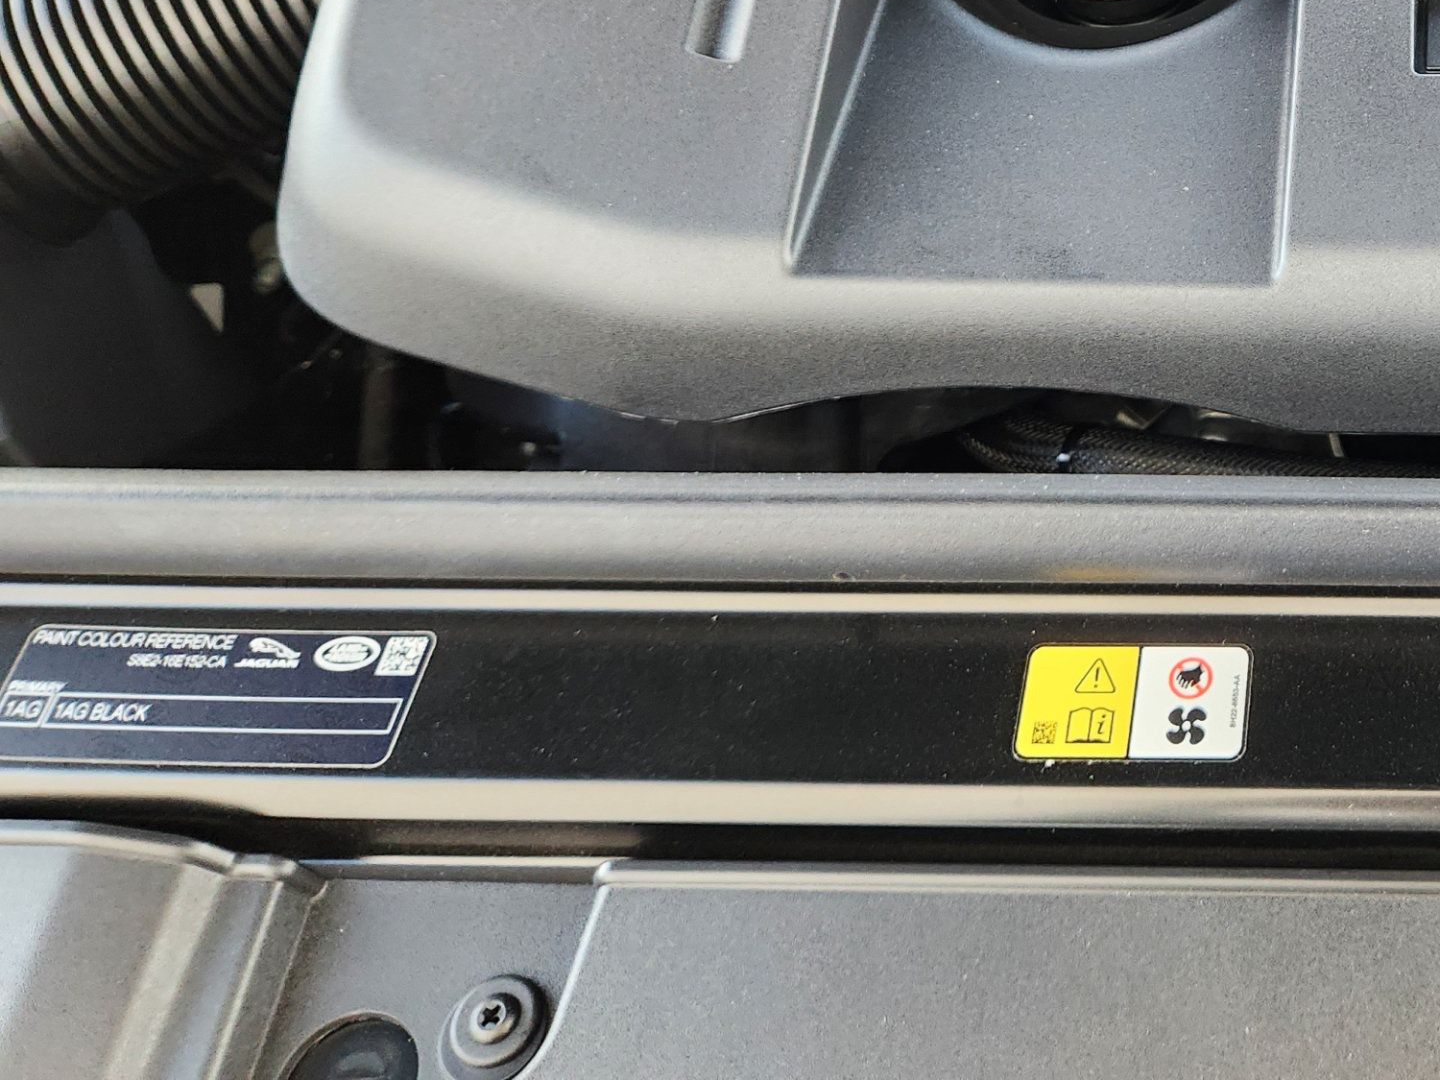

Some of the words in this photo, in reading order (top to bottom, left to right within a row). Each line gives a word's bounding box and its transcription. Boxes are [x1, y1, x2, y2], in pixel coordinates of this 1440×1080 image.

[32, 629, 80, 646] PAINT
[77, 631, 147, 648] COLOUR
[144, 633, 238, 651] REFERENCE
[5, 700, 43, 719] 1AG
[54, 701, 92, 721] 1AG
[88, 702, 153, 722] BLACK
